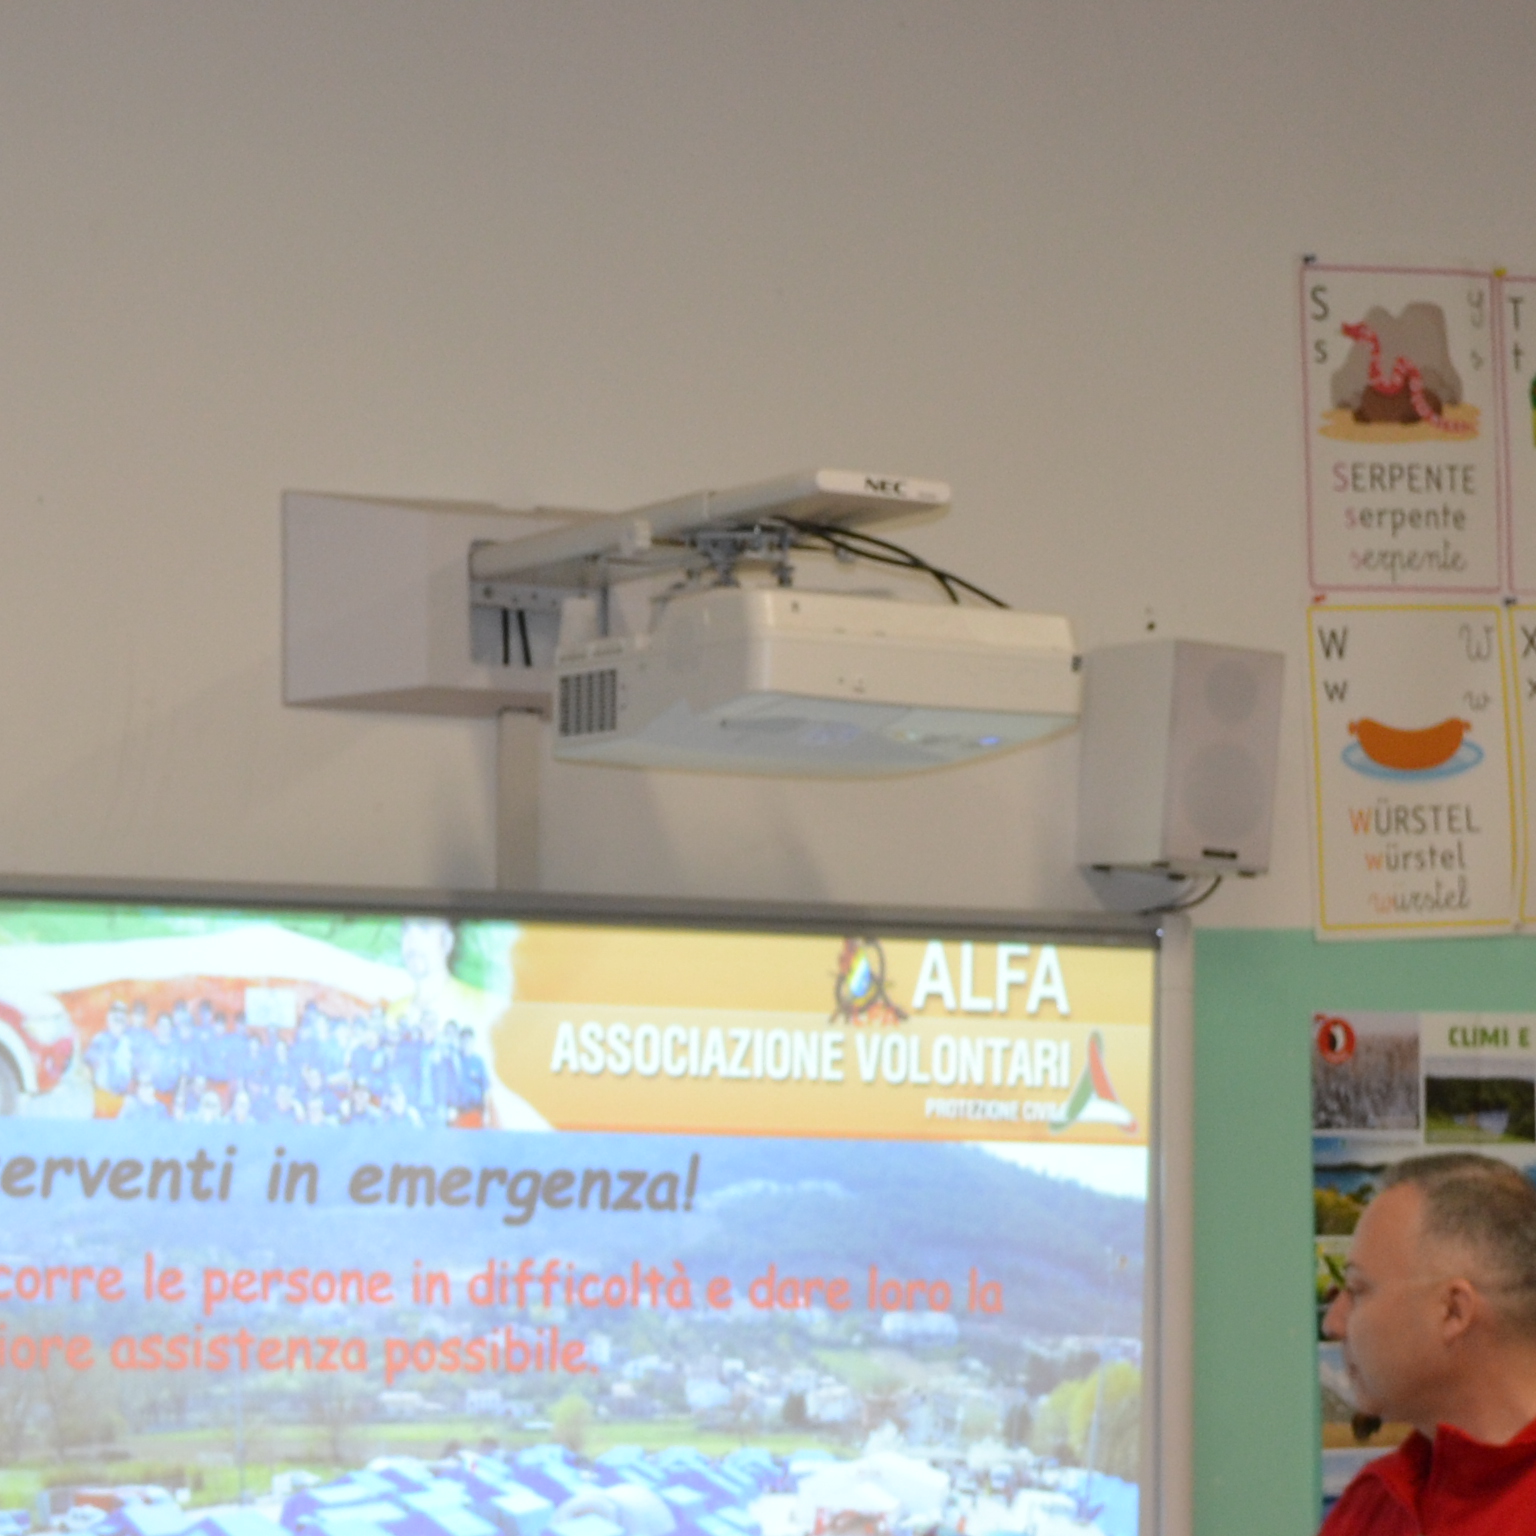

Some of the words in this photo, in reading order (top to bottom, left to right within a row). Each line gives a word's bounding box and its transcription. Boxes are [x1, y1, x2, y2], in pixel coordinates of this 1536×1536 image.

[1311, 285, 1329, 321] S
[1508, 297, 1524, 330] T
[1513, 342, 1524, 372] t
[866, 477, 906, 494] NEC
[1332, 462, 1475, 496] SERPENTE
[1345, 504, 1466, 537] serpente
[1318, 626, 1348, 660] W
[1323, 679, 1347, 702] w
[1349, 798, 1481, 836] WÜRSTEL
[1365, 840, 1468, 873] würstel
[911, 938, 1071, 1016] ALFA
[1449, 1026, 1509, 1047] CLIMI
[1519, 1026, 1530, 1047] E
[550, 1020, 844, 1082] ASSOCIAZIONE
[855, 1033, 1071, 1089] VOLONTARI
[925, 1097, 1020, 1121] PROTEZIONE
[268, 1147, 317, 1203] in
[348, 1153, 701, 1227] emergenza!
[145, 1253, 185, 1302] le
[203, 1264, 393, 1315] persone
[413, 1260, 450, 1305] in
[467, 1258, 693, 1310] difficoltà
[707, 1276, 733, 1309] e
[748, 1265, 851, 1310] dare
[868, 1266, 952, 1312] loro
[969, 1267, 1003, 1313] la
[110, 1325, 367, 1372] assistenza
[385, 1326, 599, 1385] possibile.
